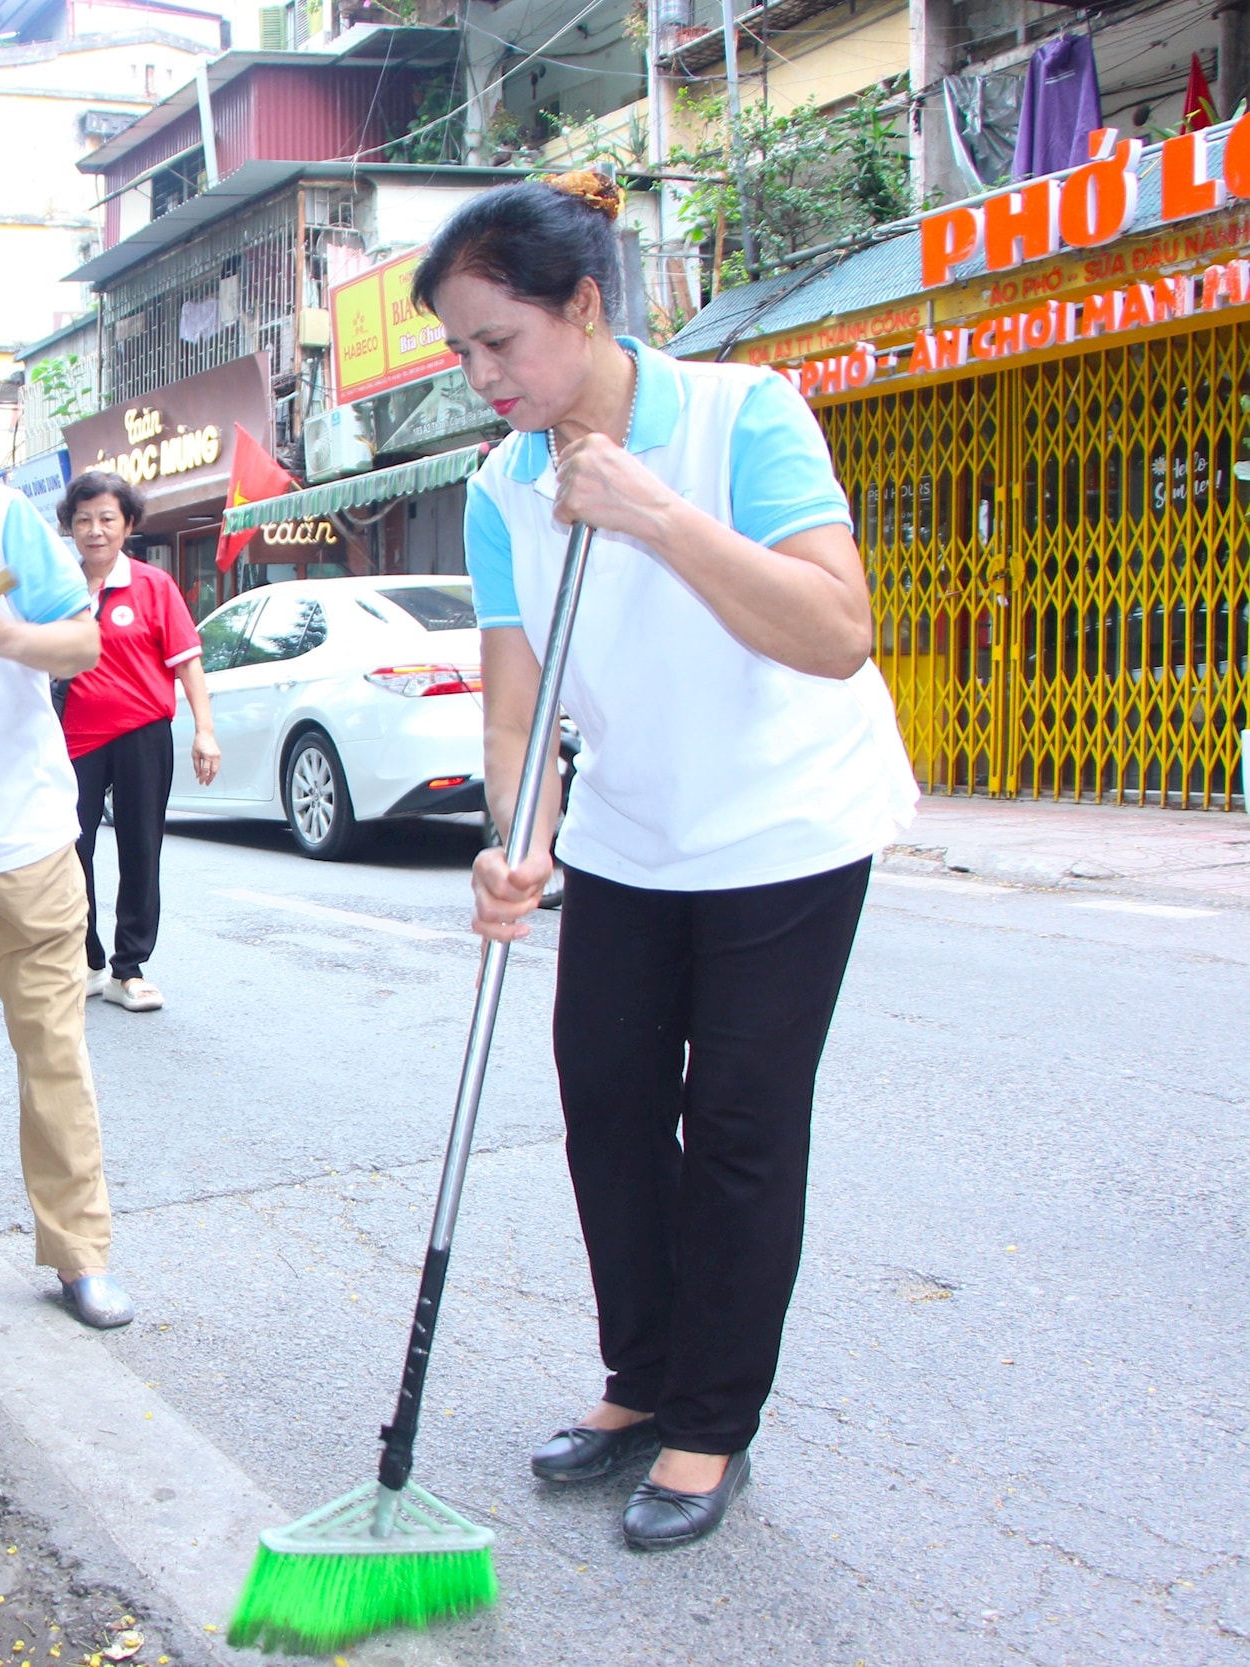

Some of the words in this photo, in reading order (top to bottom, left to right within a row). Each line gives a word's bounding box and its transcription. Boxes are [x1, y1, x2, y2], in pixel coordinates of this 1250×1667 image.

[1201, 258, 1250, 312] M
[391, 296, 414, 326] BIA
[400, 331, 417, 354] Bia
[797, 333, 815, 355] TT
[871, 306, 920, 336] CÔNG
[344, 335, 379, 362] HABECO
